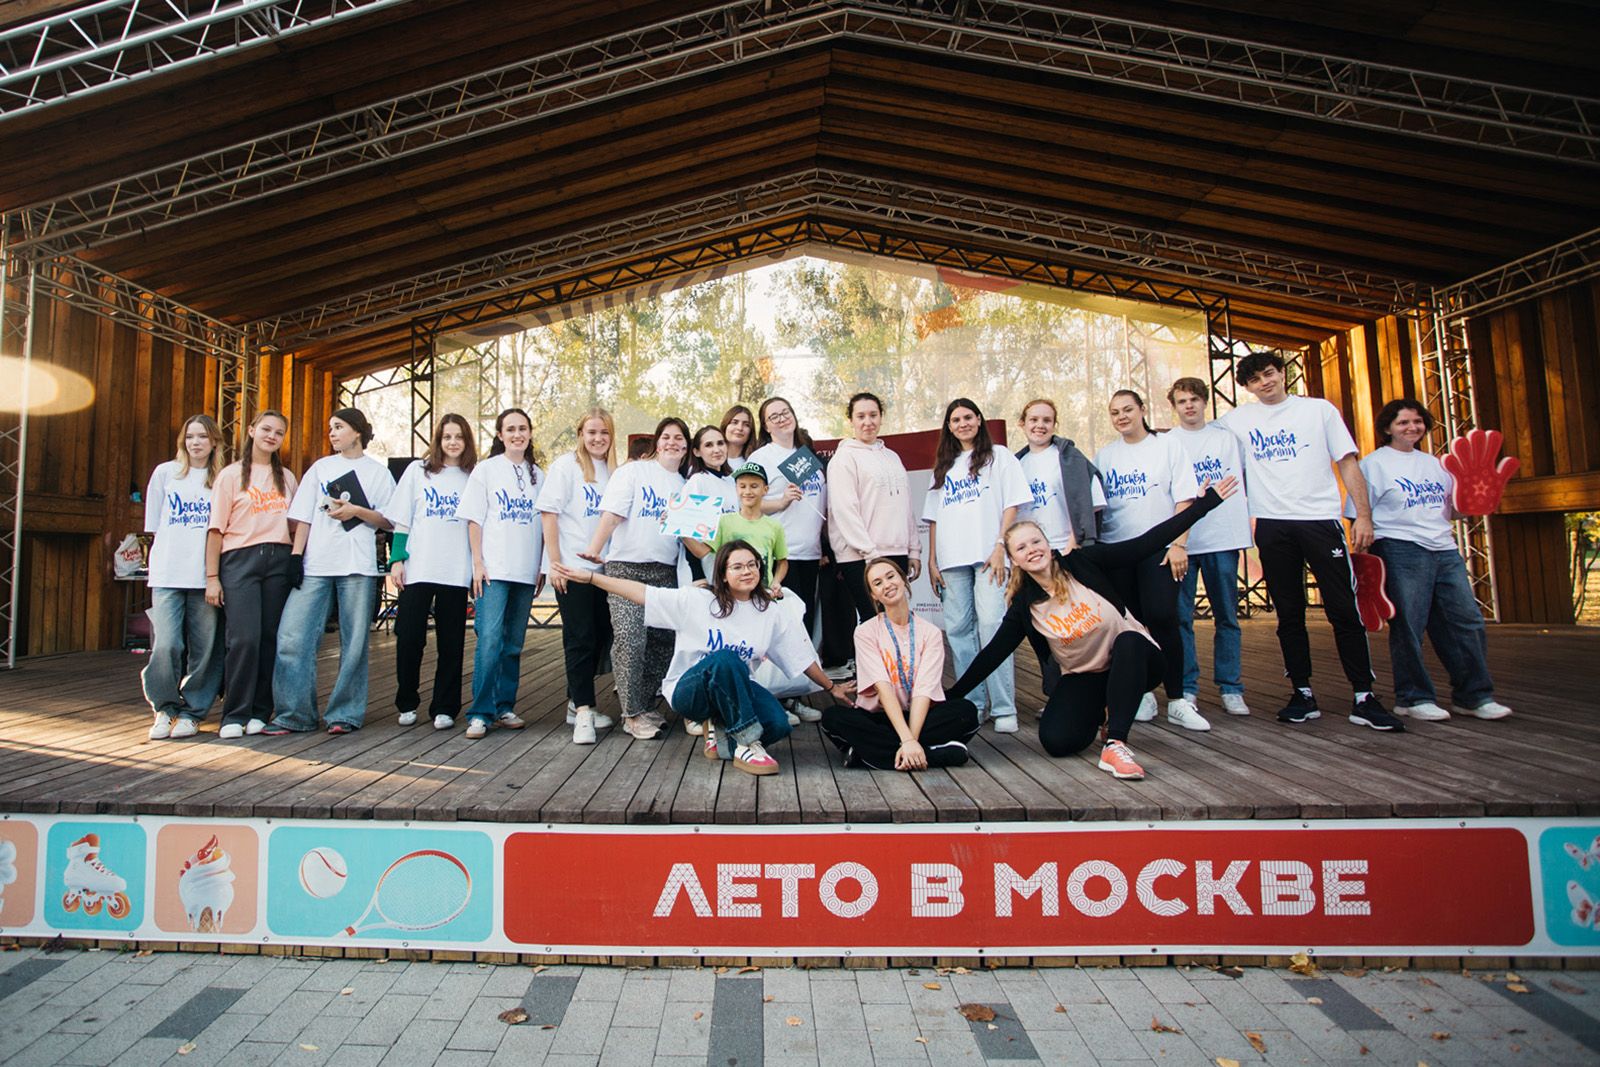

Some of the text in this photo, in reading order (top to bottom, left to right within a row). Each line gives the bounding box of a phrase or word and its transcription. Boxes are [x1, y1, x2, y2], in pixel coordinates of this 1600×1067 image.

[652, 858, 1371, 918] ЛЕТО В МОСКВЕ
